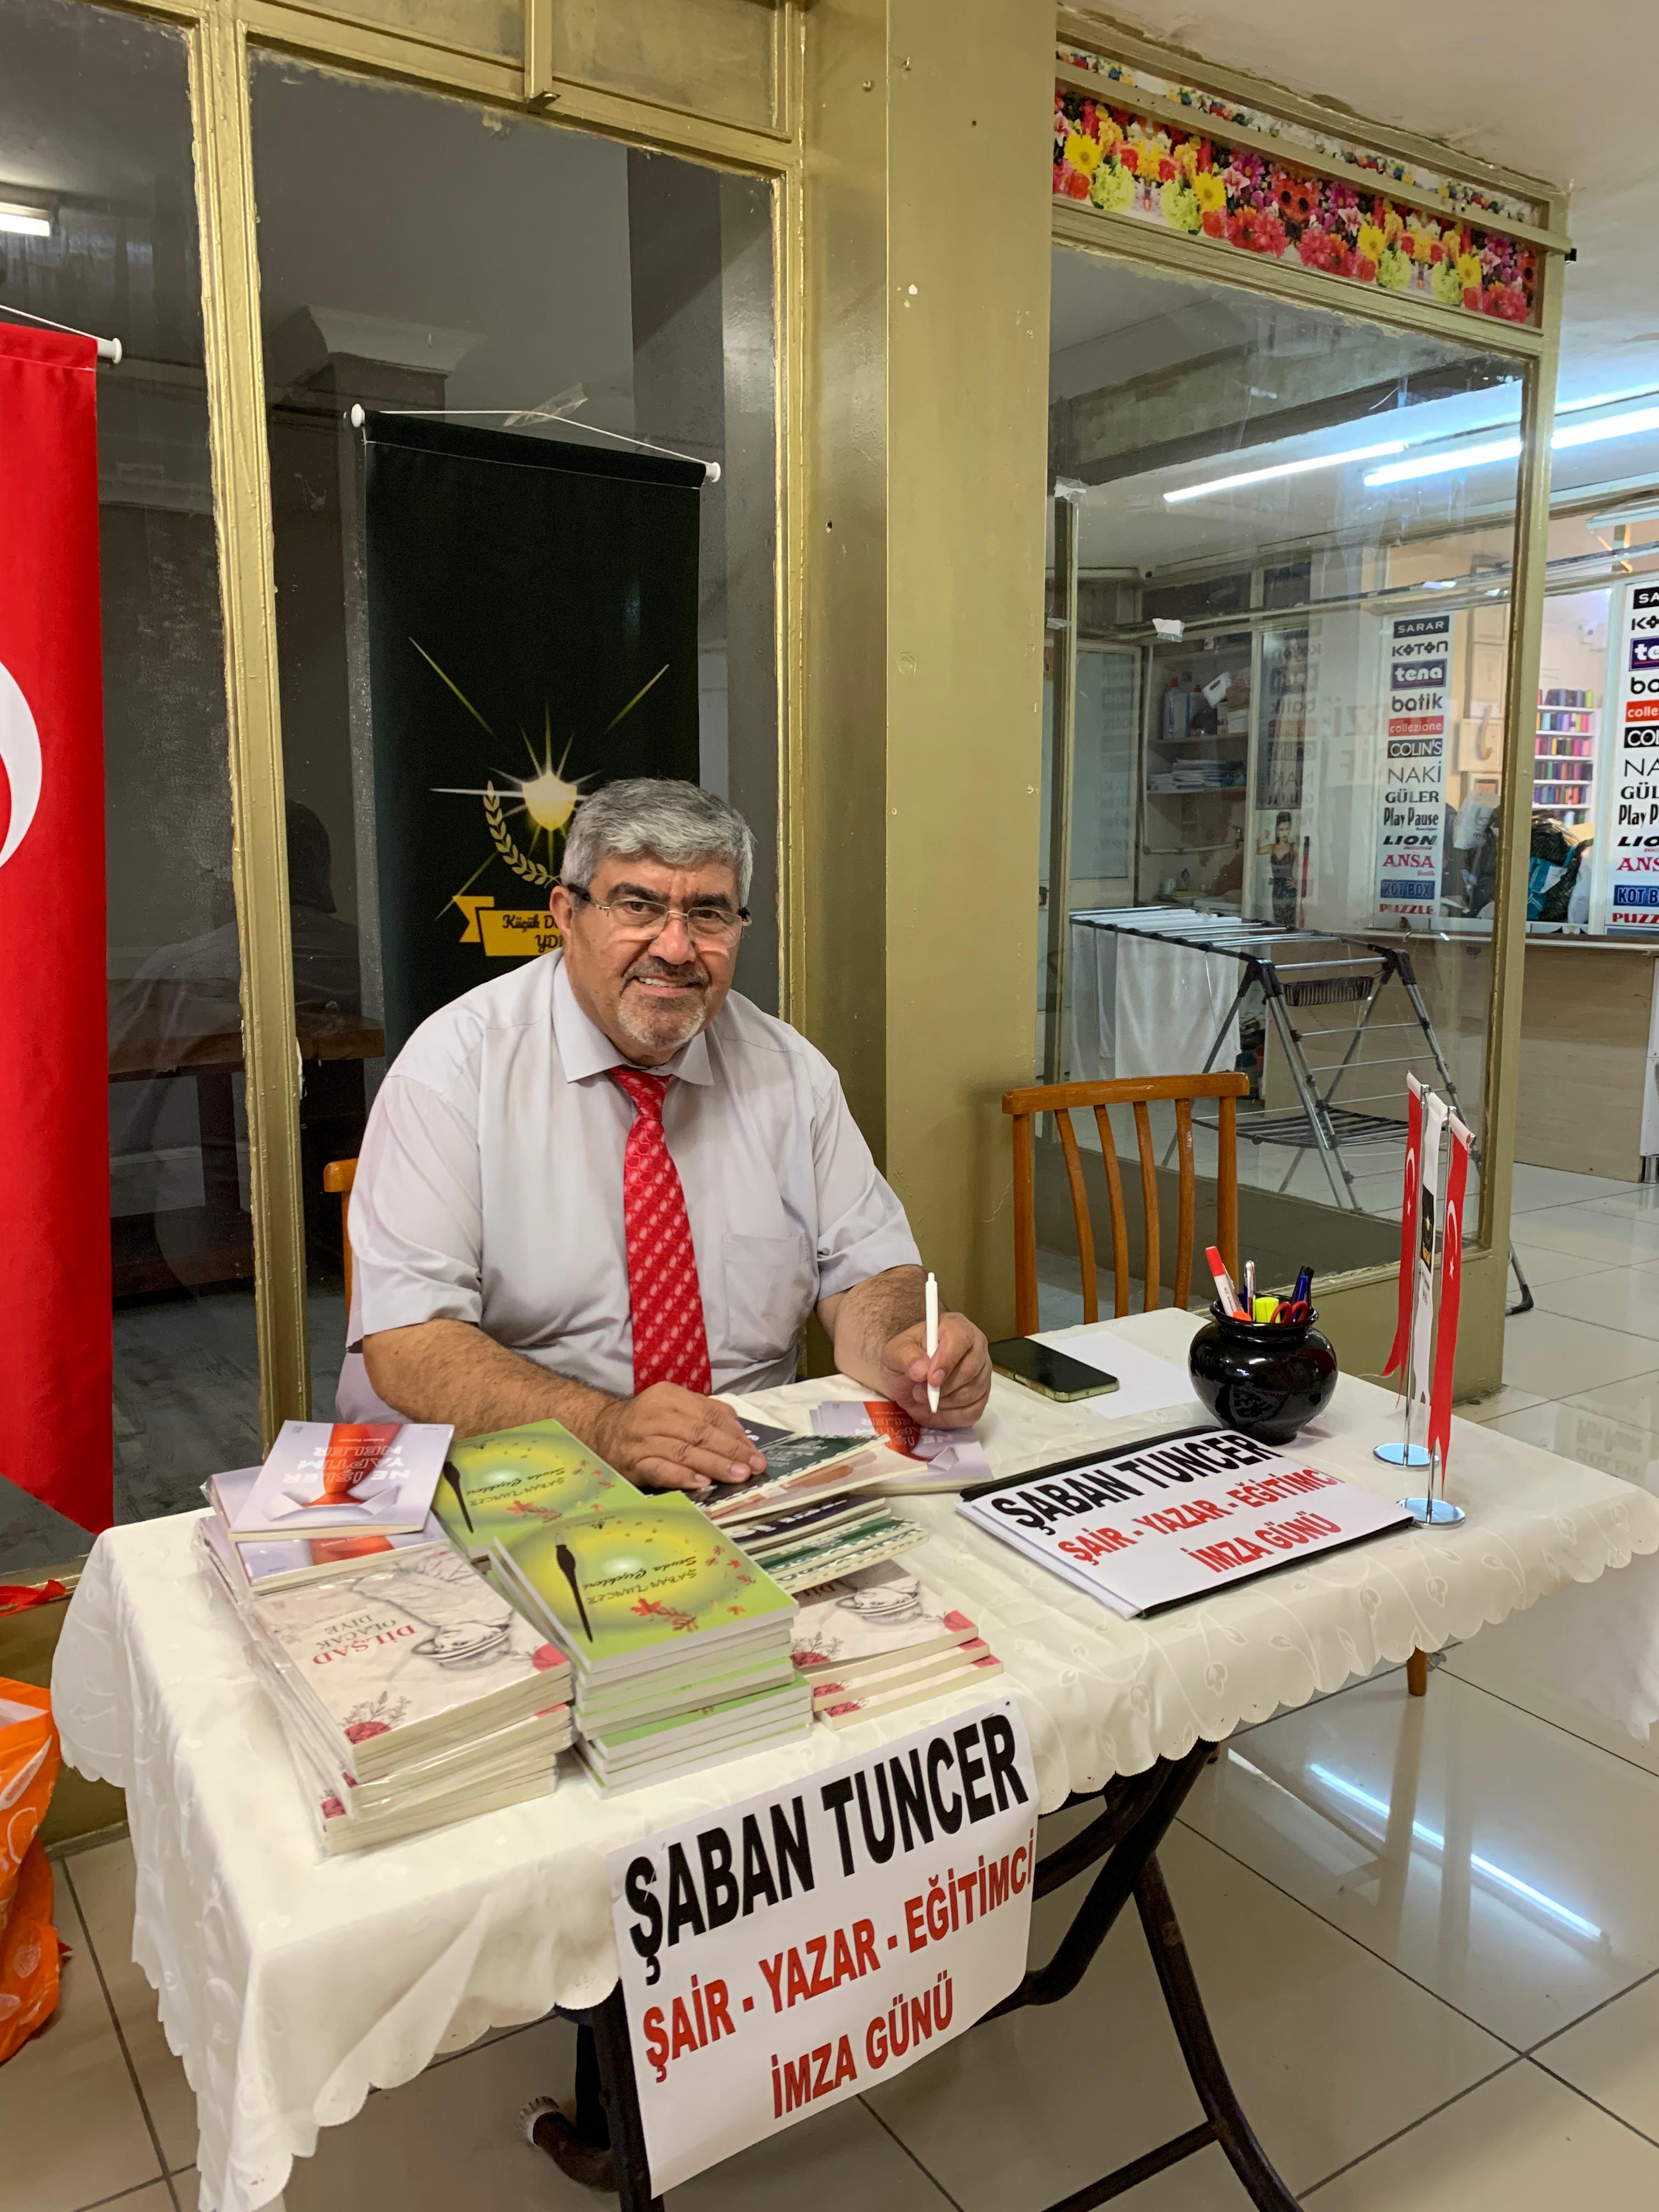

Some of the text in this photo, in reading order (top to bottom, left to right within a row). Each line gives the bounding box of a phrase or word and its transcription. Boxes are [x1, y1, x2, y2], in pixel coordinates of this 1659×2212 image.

[1397, 621, 1444, 633] SARAR
[1395, 667, 1443, 681] tena
[1392, 693, 1443, 712] batik
[1390, 723, 1442, 733] collezione
[1391, 740, 1441, 756] COLIN'S
[1387, 761, 1442, 784] NAKİ
[1385, 788, 1439, 803] GÜLER
[1384, 807, 1438, 828] Play Pause
[1618, 804, 1646, 828] Play
[1383, 836, 1437, 845] LION
[1383, 854, 1435, 868] ANSA
[1382, 882, 1431, 896] KOT BOX
[1617, 888, 1646, 904] KOT
[1379, 904, 1434, 915] PUZZLE
[503, 914, 540, 933] Küçük
[313, 1445, 403, 1457] NELER
[991, 1434, 1284, 1536] ŞABAN TUNCER
[1058, 1527, 1138, 1565] ŞAİR
[1132, 1499, 1234, 1535] YAZAR
[1226, 1466, 1346, 1508] EĞİTİMCİ
[1180, 1511, 1342, 1573] İMZA GÜNÜ
[313, 1624, 417, 1664] DİLŞAD
[316, 1620, 396, 1650] OLACAK
[625, 1713, 1030, 1986] ŞABAN TUNCER
[643, 1974, 737, 2083] ŞAİR
[758, 1918, 881, 2014] YAZAR
[904, 1827, 1036, 1954] EĞİTİMCİ
[771, 1970, 954, 2119] İMZA GÜNÜ
